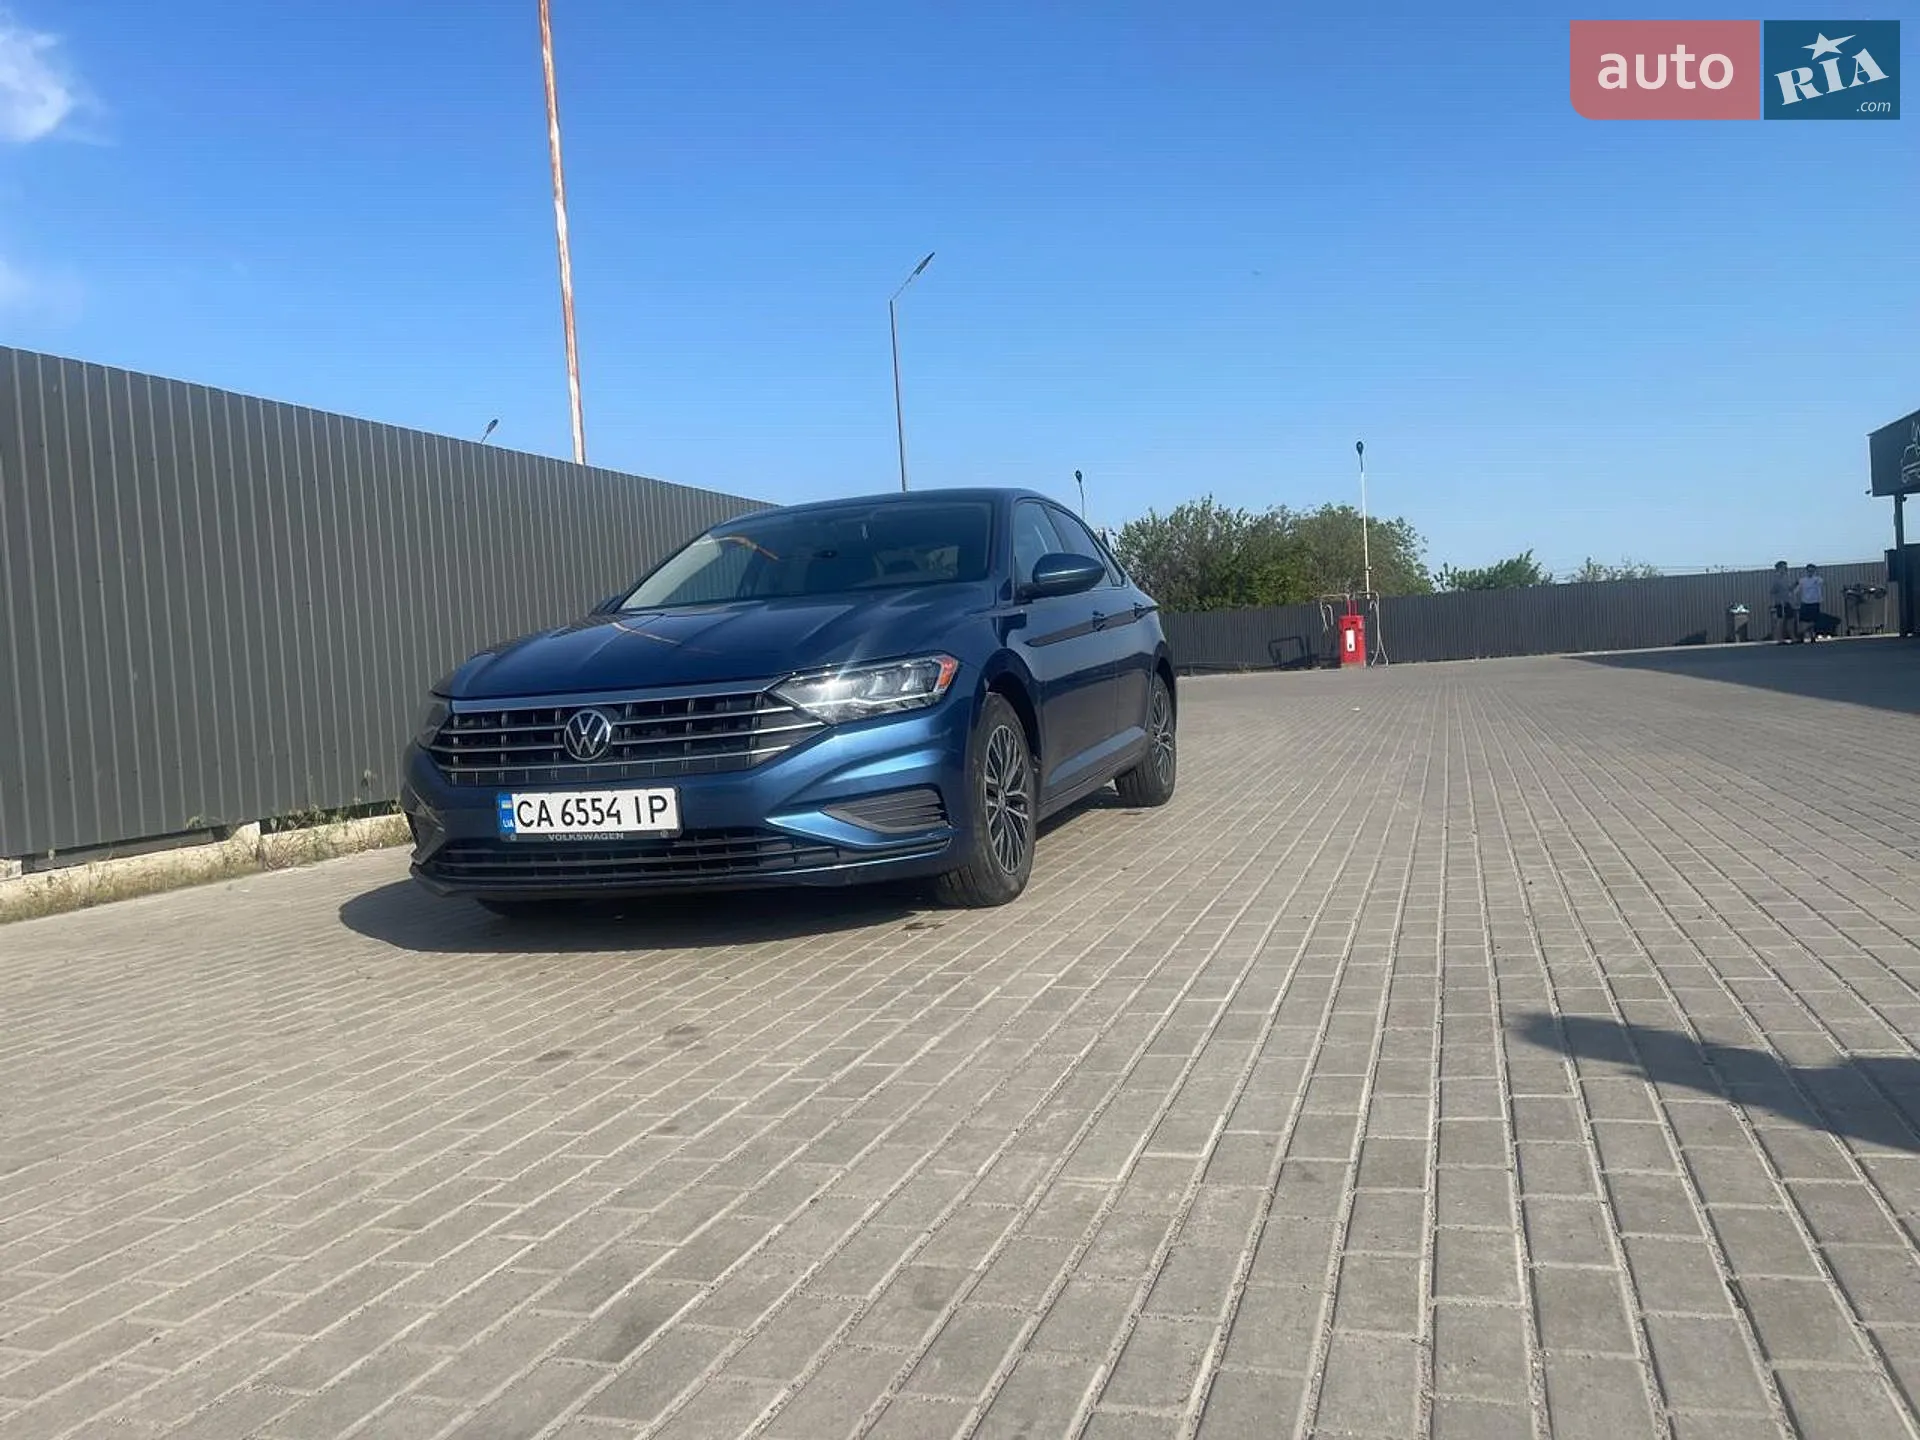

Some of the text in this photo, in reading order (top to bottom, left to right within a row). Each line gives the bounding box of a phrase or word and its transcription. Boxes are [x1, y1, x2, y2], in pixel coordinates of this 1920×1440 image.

[517, 795, 668, 828] CA 6554 IP
[503, 819, 515, 828] UA
[548, 832, 624, 841] VOLKSWAGEN
